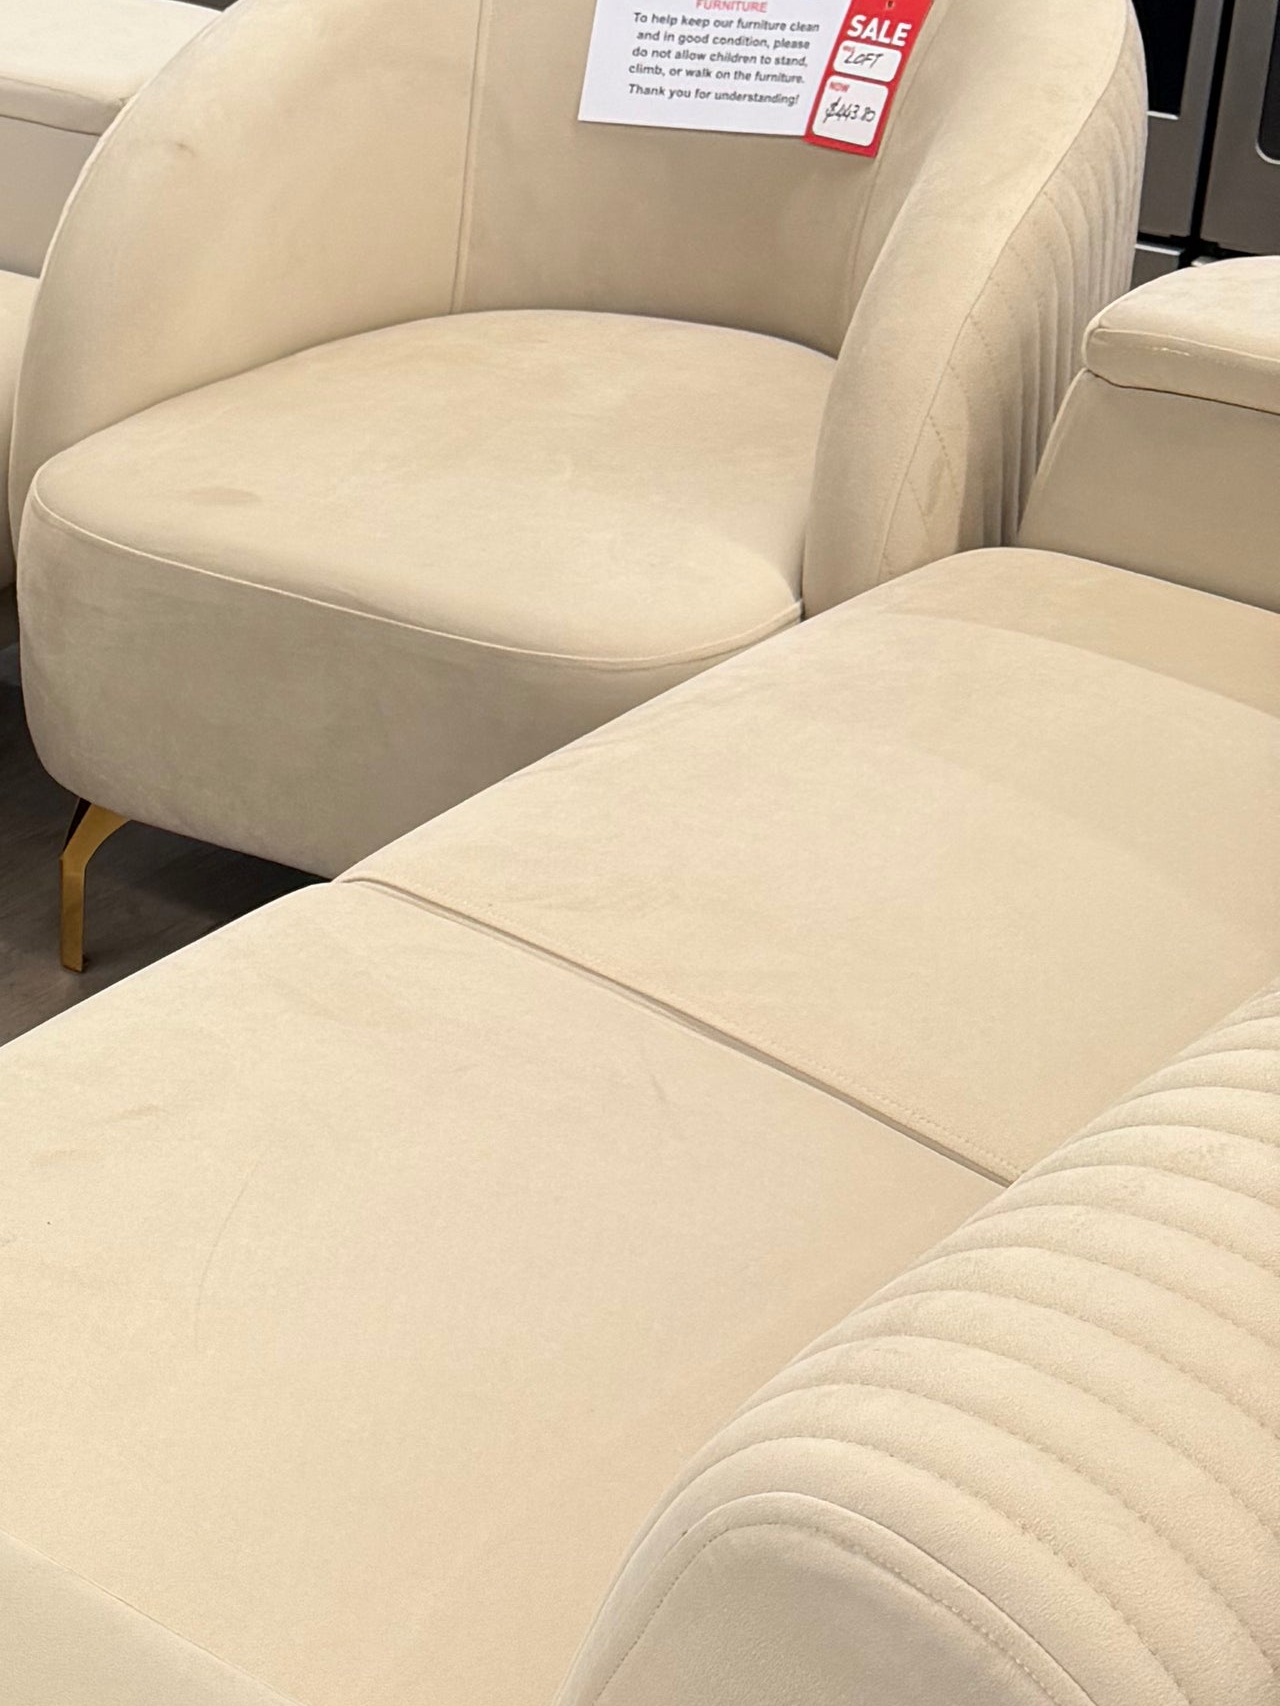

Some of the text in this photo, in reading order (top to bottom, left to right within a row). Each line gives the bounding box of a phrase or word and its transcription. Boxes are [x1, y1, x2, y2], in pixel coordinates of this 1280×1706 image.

[634, 12, 820, 32] To help keep our furniture clean
[847, 14, 912, 46] SALE
[637, 30, 810, 50] and in good condition, please
[632, 46, 808, 67] do not allow children to stand,
[844, 49, 883, 68] LOFT
[628, 63, 805, 84] climb, or walk on the furniture.
[629, 83, 800, 107] Thank you for understanding!
[829, 81, 850, 92] NOW
